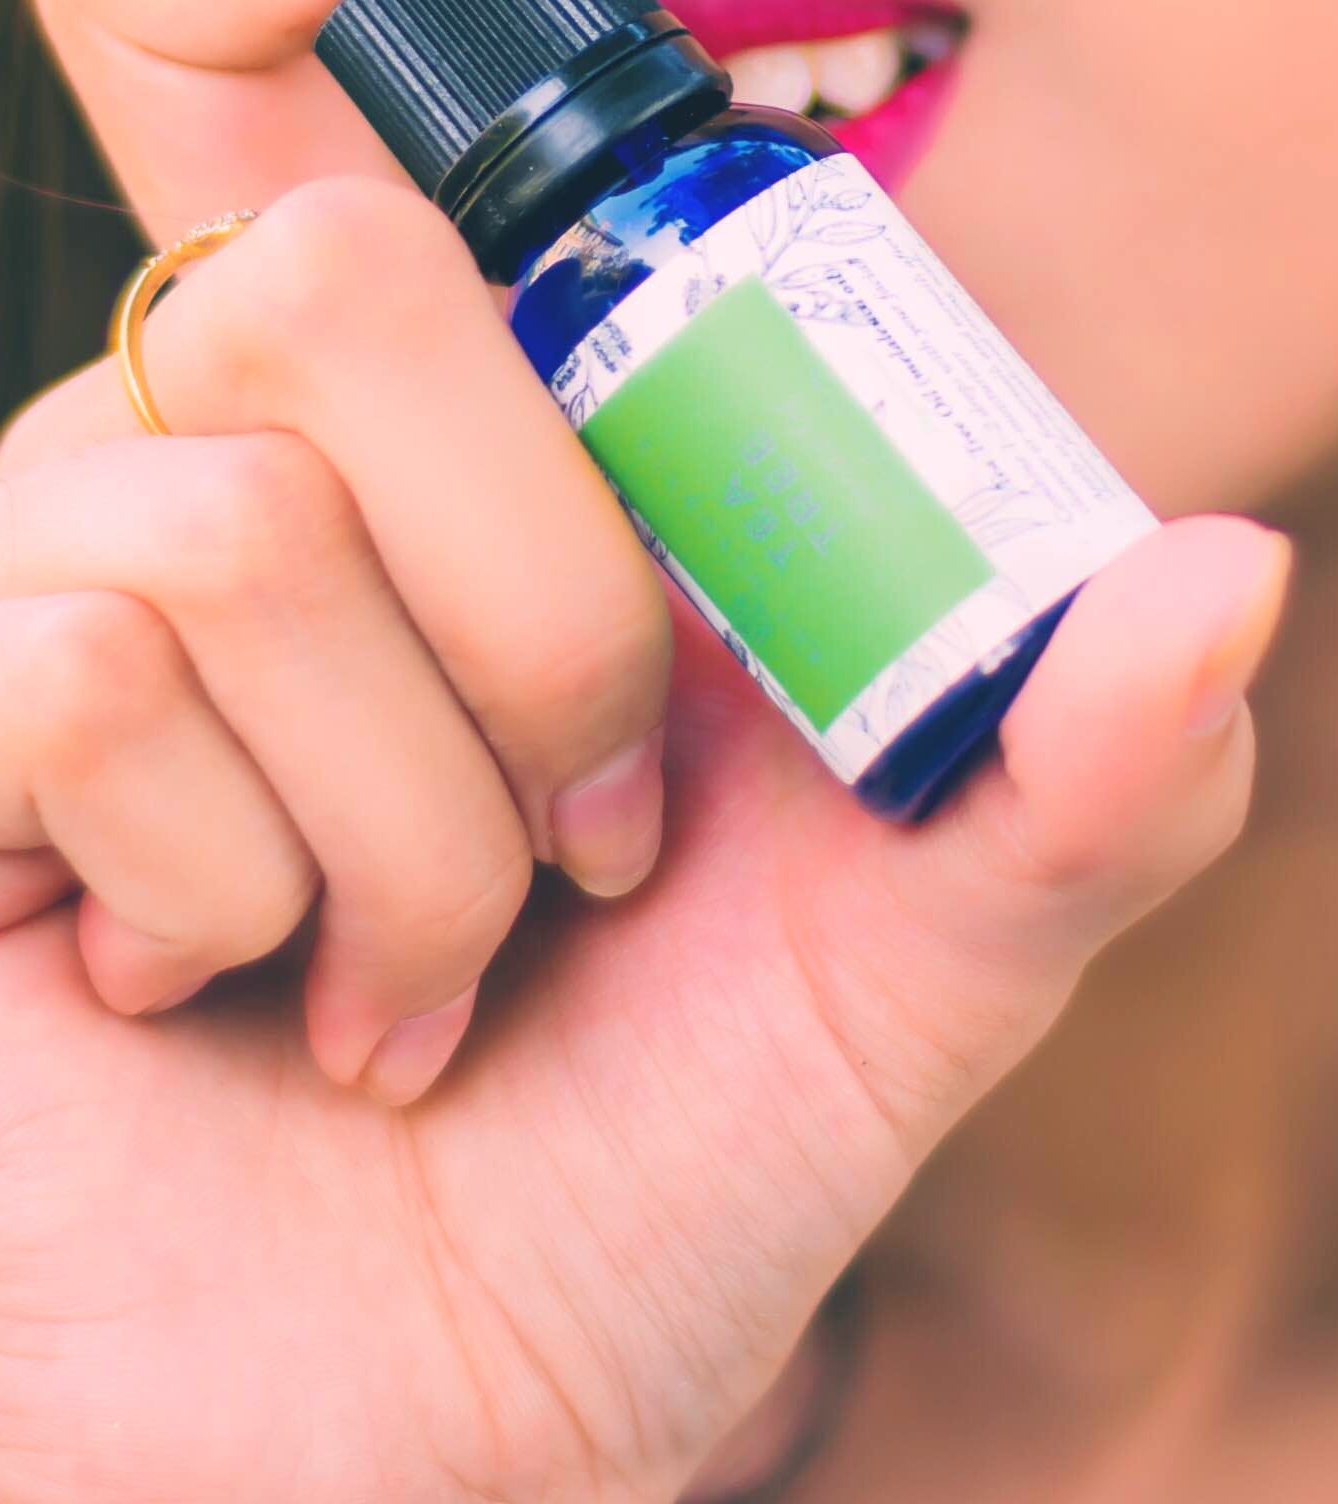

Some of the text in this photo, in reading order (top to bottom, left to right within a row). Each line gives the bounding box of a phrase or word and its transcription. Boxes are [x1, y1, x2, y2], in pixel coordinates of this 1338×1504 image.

[890, 301, 927, 336] your
[920, 387, 955, 419] Oil
[952, 419, 985, 456] Tree
[731, 424, 853, 560] TREE
[723, 467, 798, 575] TEA
